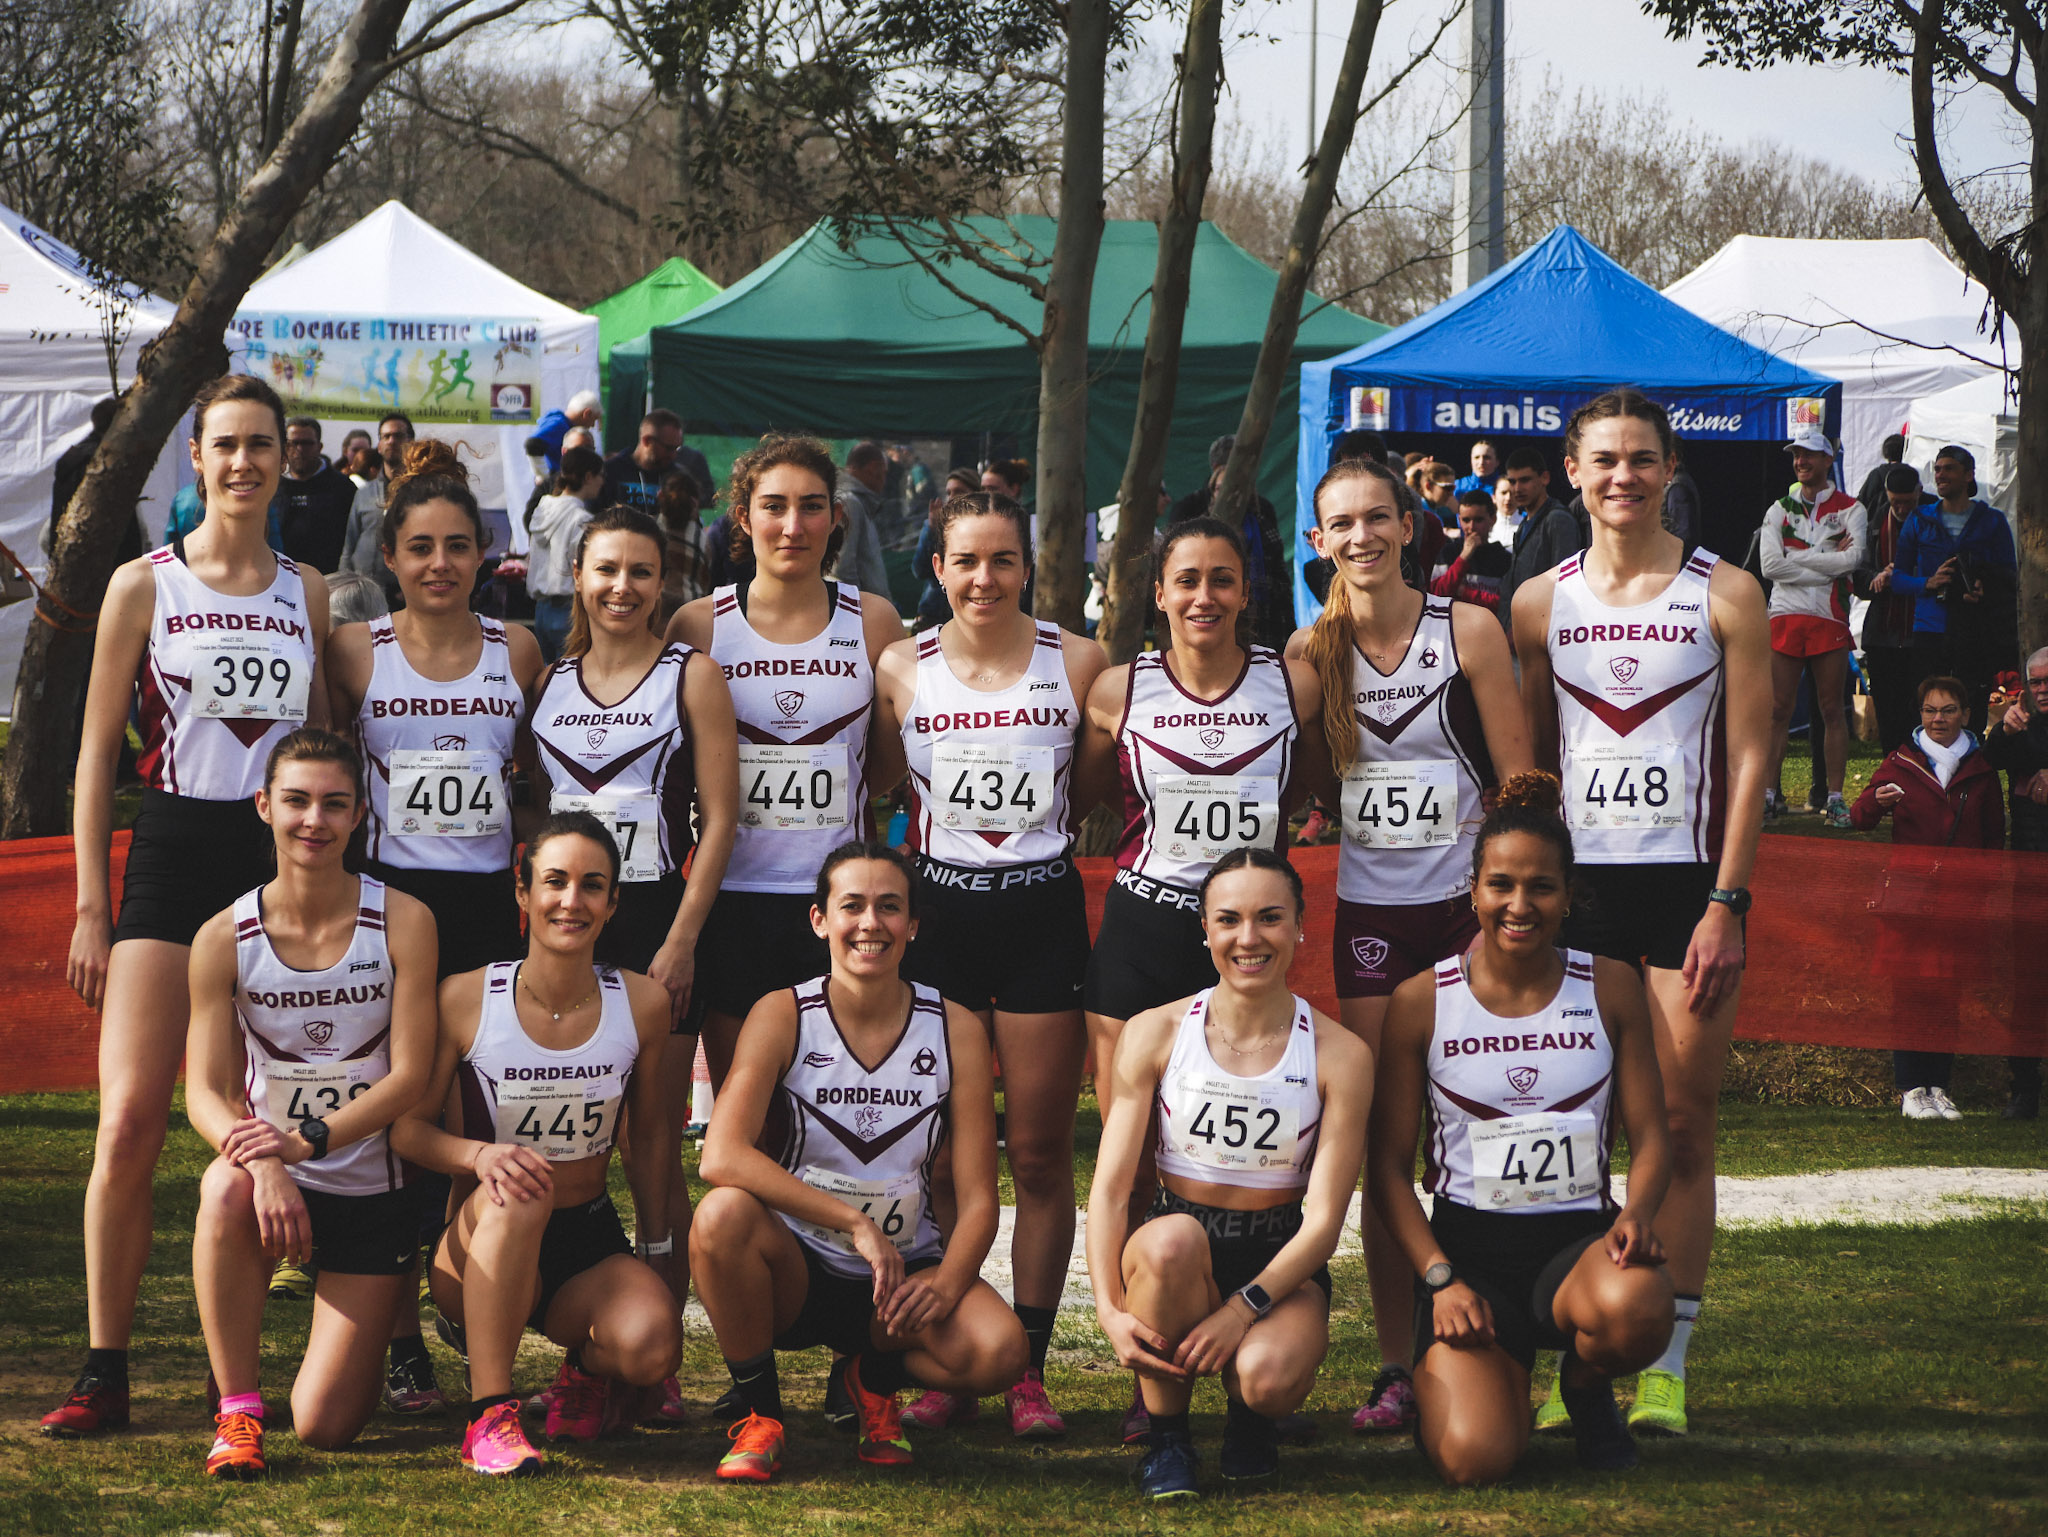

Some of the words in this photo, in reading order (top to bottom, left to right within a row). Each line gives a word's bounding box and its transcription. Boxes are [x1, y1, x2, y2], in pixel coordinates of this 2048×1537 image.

[273, 315, 360, 340] BOCAGE
[370, 317, 471, 342] ATHLETIC
[480, 320, 537, 343] CLUB
[1434, 397, 1562, 431] aunis
[1668, 603, 1700, 613] poli
[166, 613, 305, 645] BORDEAUX
[1559, 624, 1698, 646] BORDEAUX
[829, 639, 859, 648] poli
[213, 656, 291, 699] 399
[720, 659, 858, 680] BORDEAUX
[1029, 681, 1058, 691] poli
[372, 697, 517, 719] BORDEAUX
[552, 713, 654, 727] BORDEAUX
[915, 707, 1069, 734] BORDEAUX
[1153, 712, 1270, 728] BORDEAUX
[406, 775, 493, 816] 404
[748, 769, 832, 810] 440
[949, 770, 1036, 812] 434
[1586, 766, 1669, 808] 448
[1358, 786, 1441, 828] 454
[1174, 801, 1260, 841] 405
[603, 821, 638, 862] 7
[923, 863, 995, 892] NIKE
[1000, 859, 1067, 890] PRO
[350, 961, 379, 973] poli
[248, 982, 387, 1009] BORDEAUX
[1562, 1009, 1593, 1018] poli
[1444, 1032, 1596, 1058] BORDEAUX
[504, 1064, 614, 1081] BORDEAUX
[816, 1087, 922, 1107] BORDEAUX
[515, 1100, 605, 1142] 445
[1189, 1101, 1281, 1151] 452
[1501, 1135, 1575, 1185] 421
